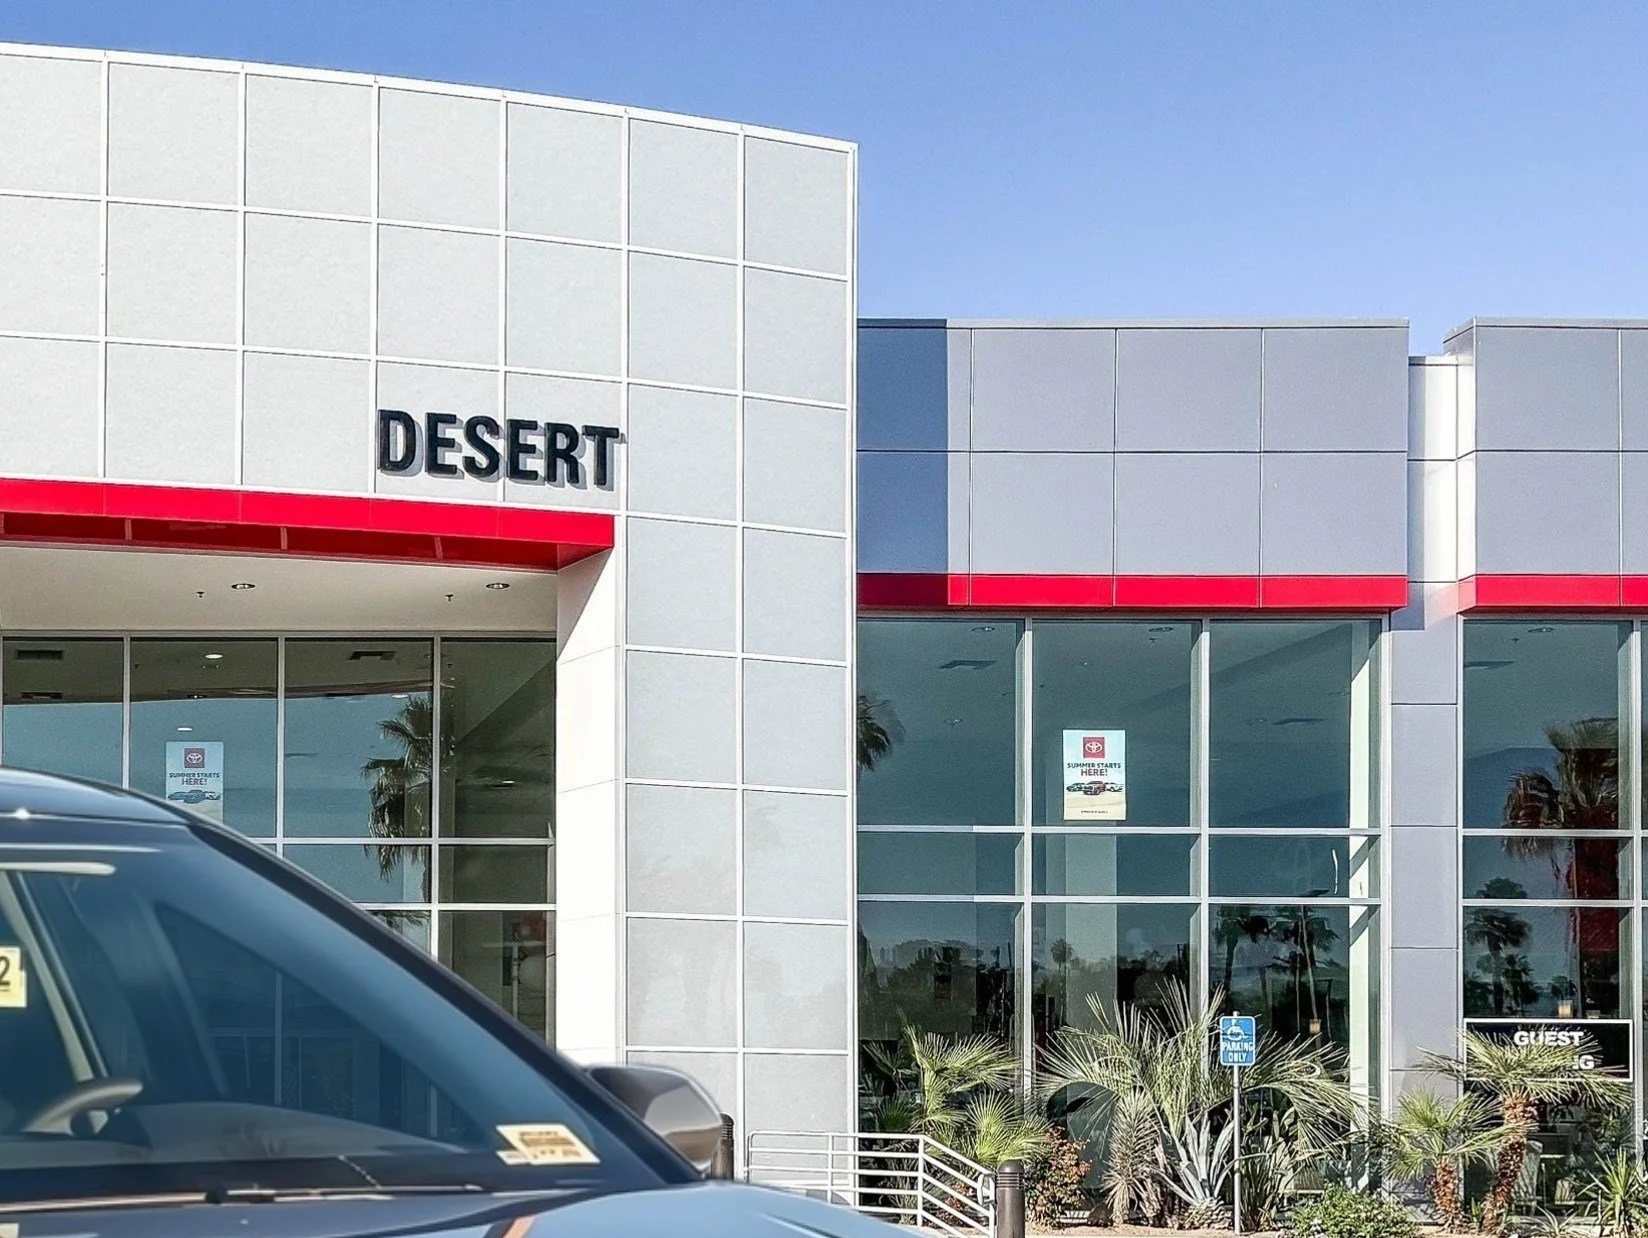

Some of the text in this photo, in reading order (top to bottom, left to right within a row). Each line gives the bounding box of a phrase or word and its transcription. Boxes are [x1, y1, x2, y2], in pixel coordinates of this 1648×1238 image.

[377, 409, 620, 487] DESERT
[1080, 768, 1108, 776] HERE!
[181, 778, 208, 786] HERE!
[1513, 1030, 1585, 1047] GUEST
[1222, 1041, 1254, 1052] PARKING
[1228, 1051, 1248, 1062] ONLY
